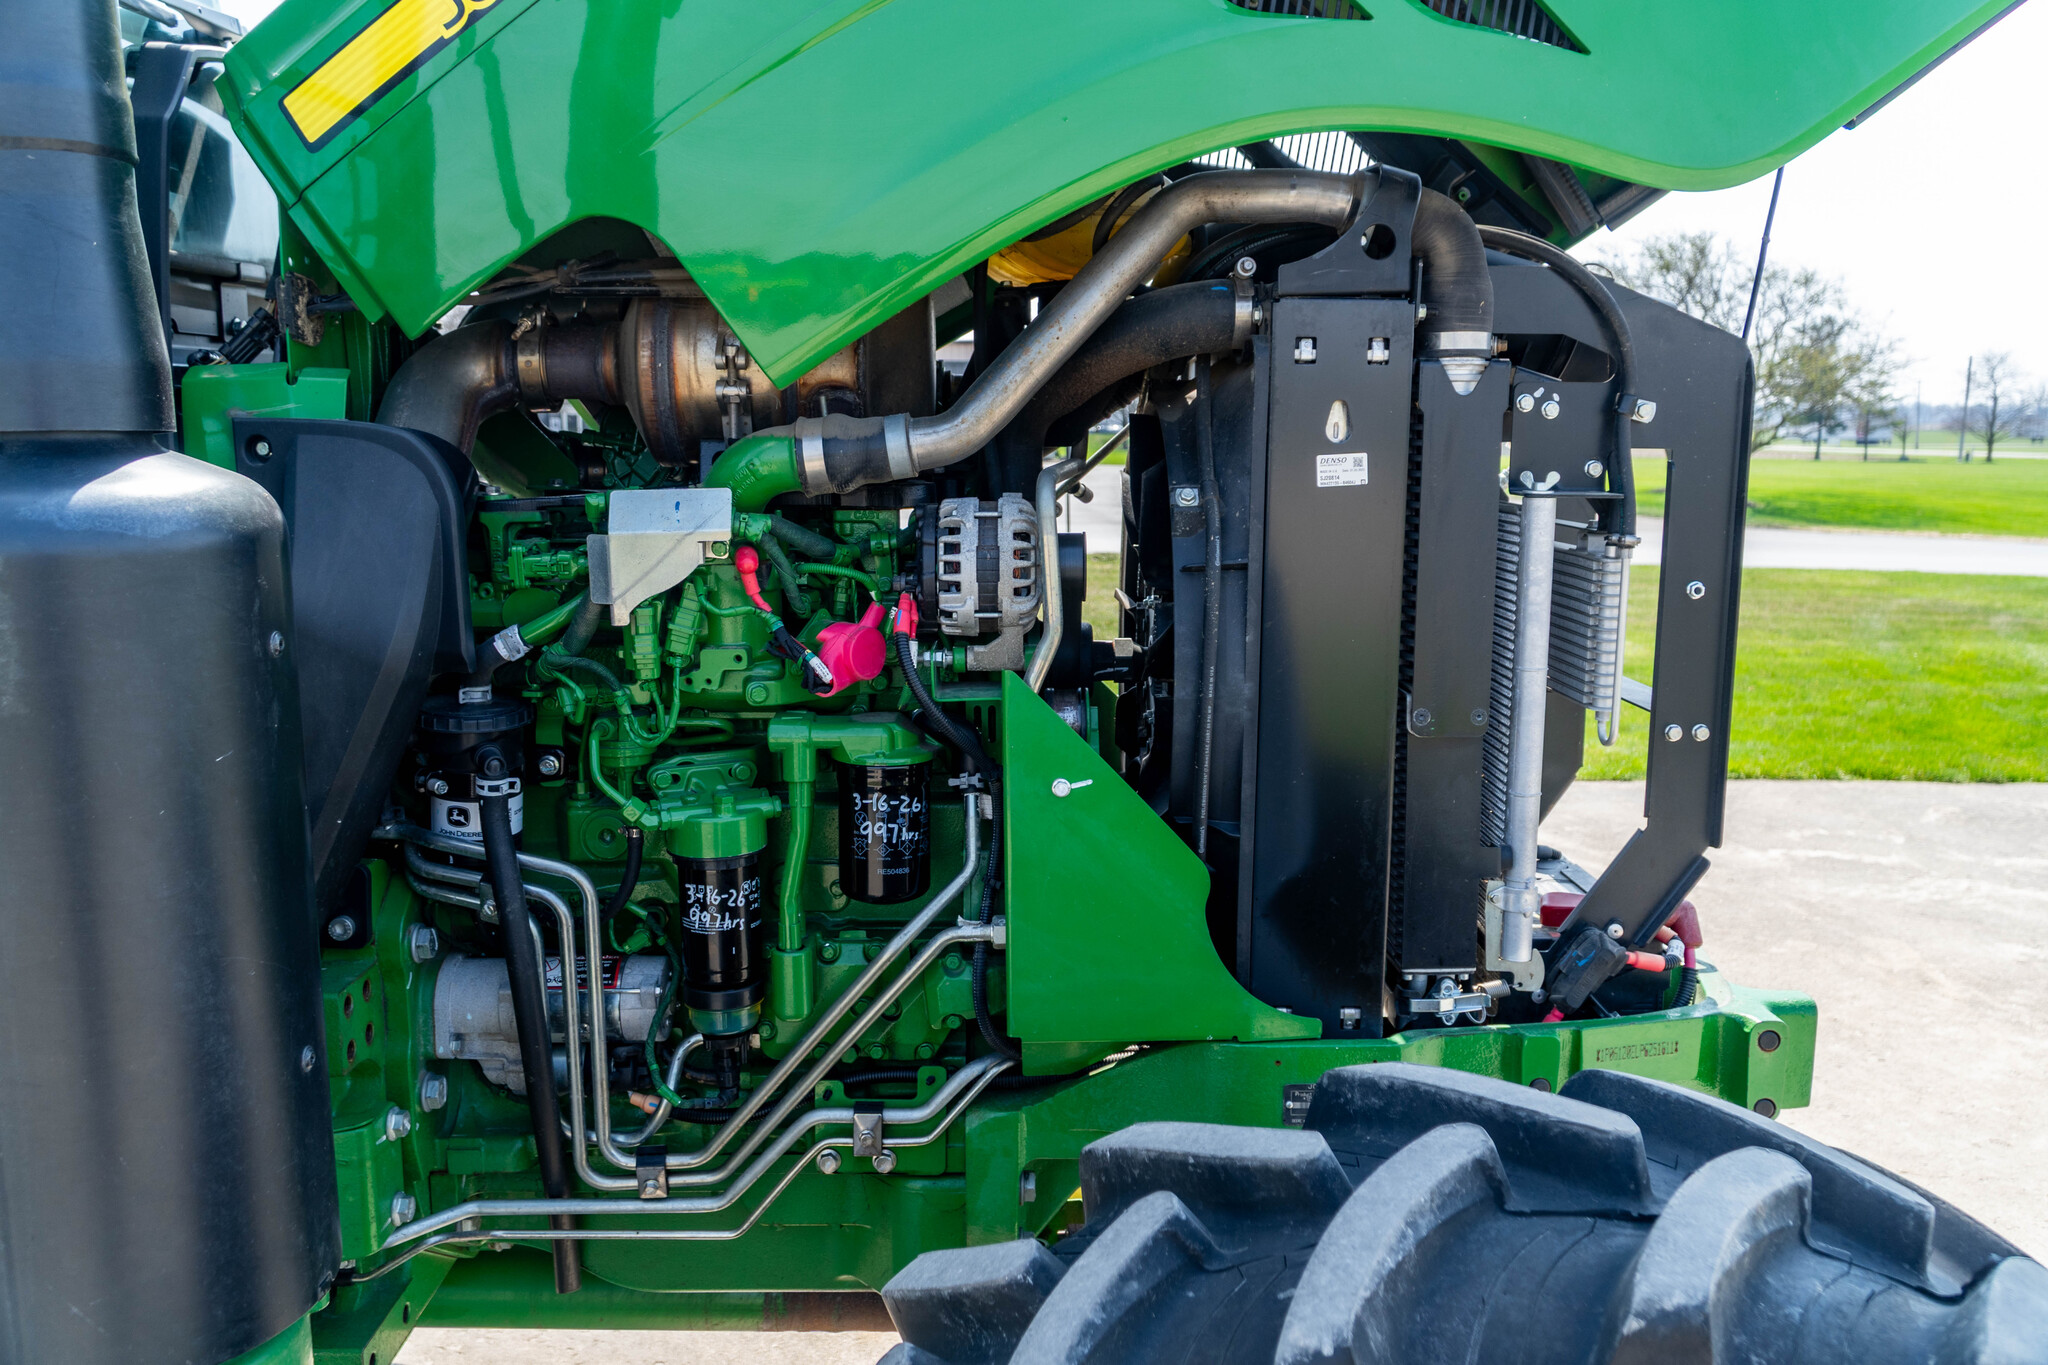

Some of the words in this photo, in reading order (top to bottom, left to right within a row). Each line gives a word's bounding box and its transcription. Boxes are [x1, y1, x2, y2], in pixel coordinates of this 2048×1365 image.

[853, 793, 921, 812] 3-16-26
[439, 828, 455, 836] JOHN
[877, 867, 910, 875] RE504836
[685, 883, 745, 907] 3-16-26
